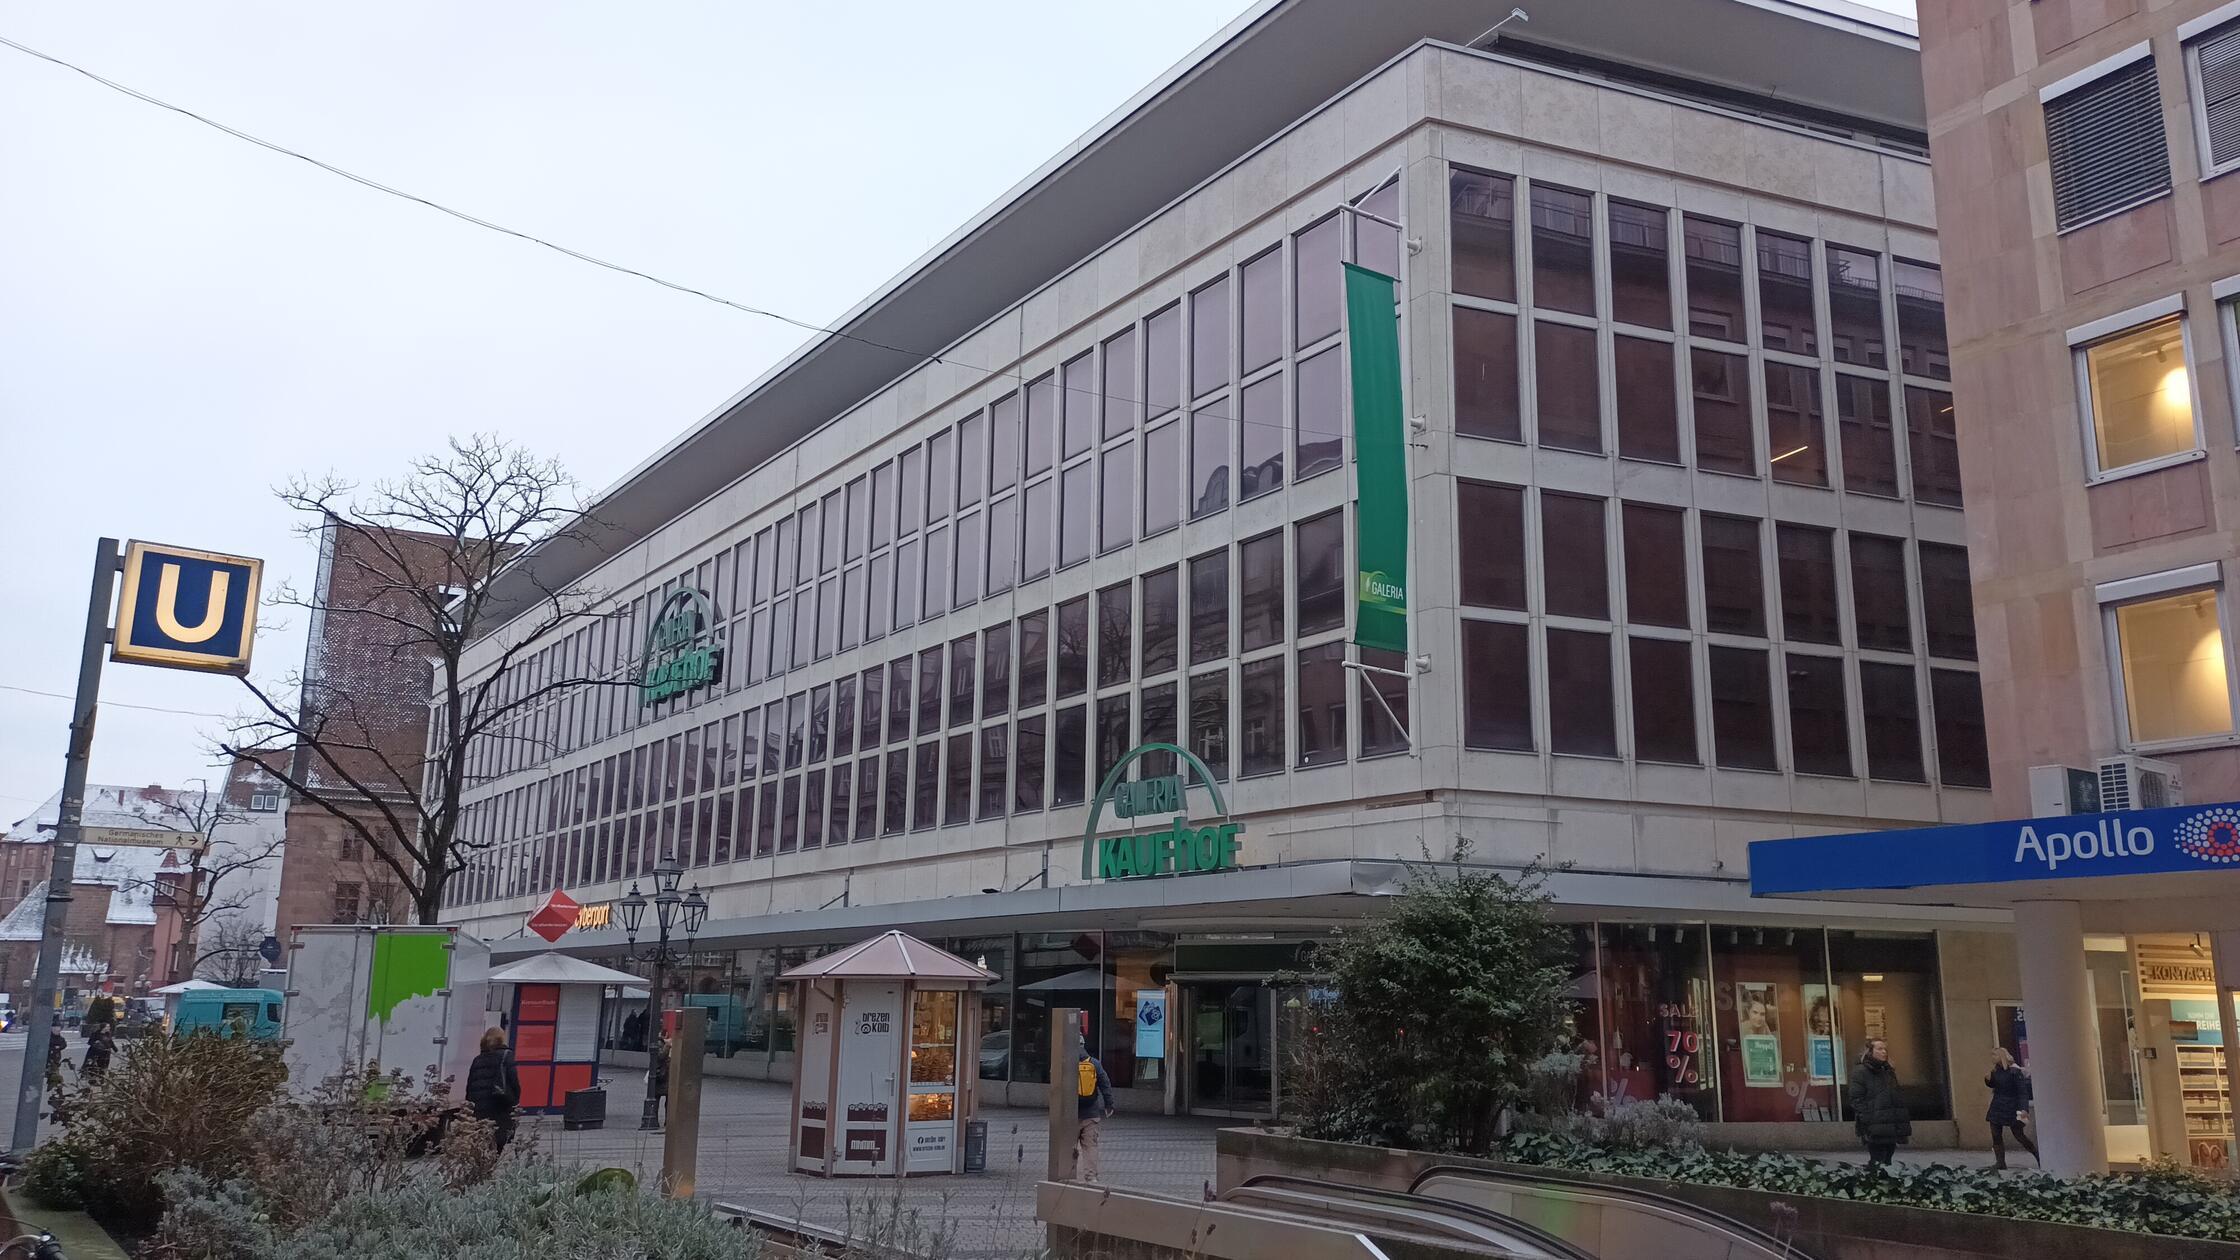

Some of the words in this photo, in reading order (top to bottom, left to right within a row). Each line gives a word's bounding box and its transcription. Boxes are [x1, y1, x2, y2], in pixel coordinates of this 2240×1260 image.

[1371, 581, 1404, 601] GALERIA
[156, 563, 230, 643] U
[1114, 774, 1188, 818] GALERIA
[97, 836, 164, 846] Nationalmuseum
[108, 829, 164, 839] Germanisches
[2014, 818, 2155, 870] Apollo
[1665, 1031, 1699, 1053] 70
